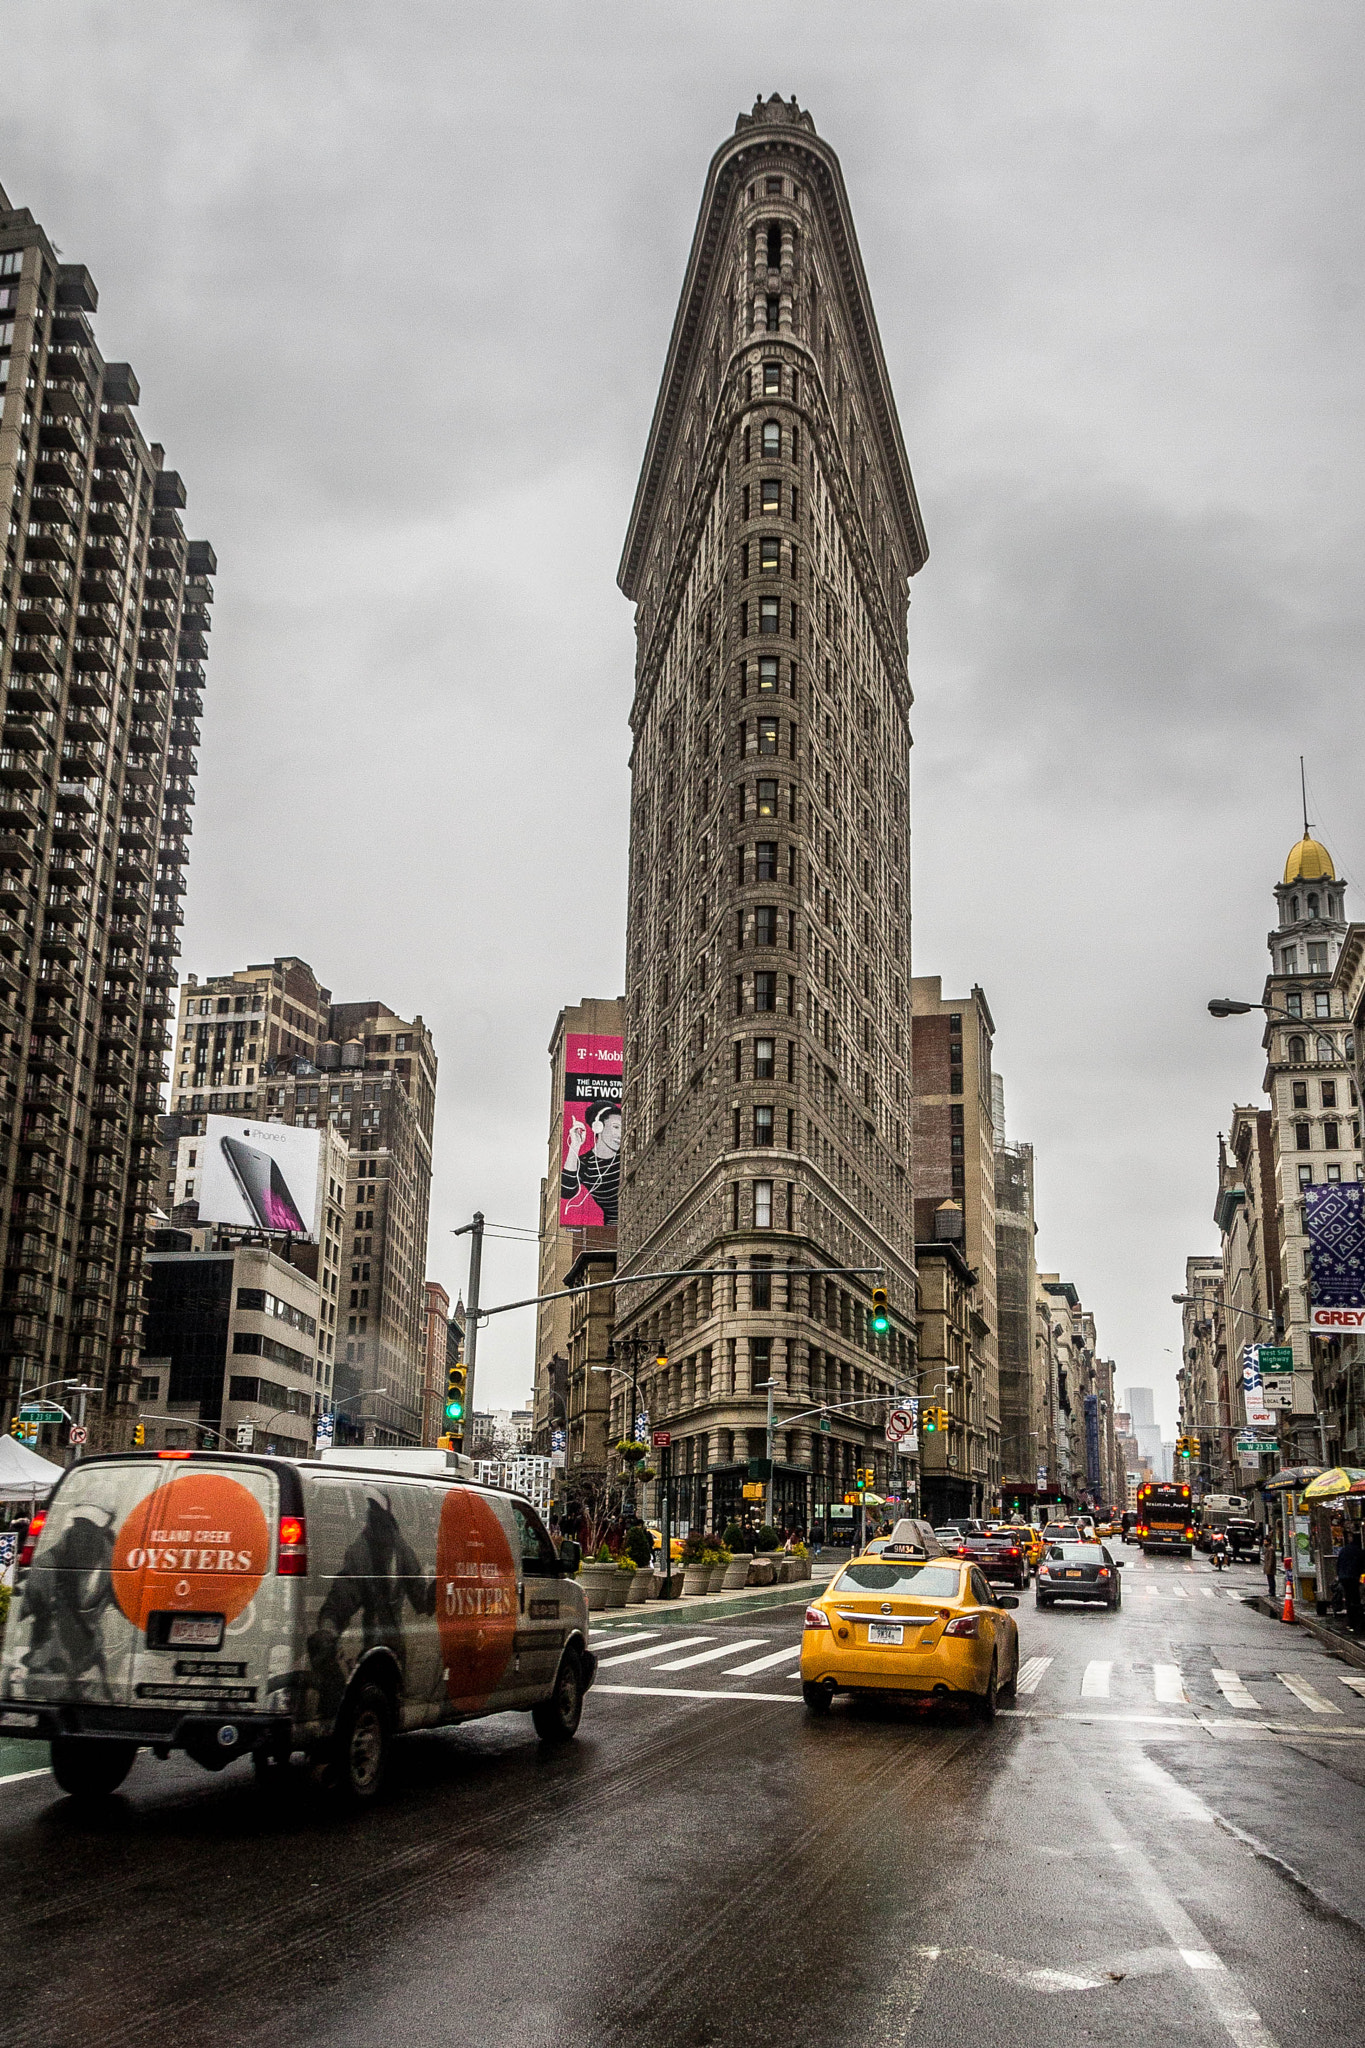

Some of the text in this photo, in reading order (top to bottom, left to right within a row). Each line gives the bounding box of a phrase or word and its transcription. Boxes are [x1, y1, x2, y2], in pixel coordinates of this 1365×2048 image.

[577, 1078, 590, 1086] THE
[252, 1128, 286, 1142] iPhone 6
[1309, 1202, 1341, 1230] MAD.
[1323, 1223, 1347, 1242] SQ.
[1338, 1228, 1365, 1255] ART.
[1315, 1310, 1365, 1326] GREY
[1262, 1356, 1289, 1364] Highway
[150, 1529, 233, 1544] ISLAND CREEK
[893, 1544, 914, 1554] 9M34
[126, 1548, 252, 1571] OYSTERS
[445, 1588, 511, 1616] OYSTERS
